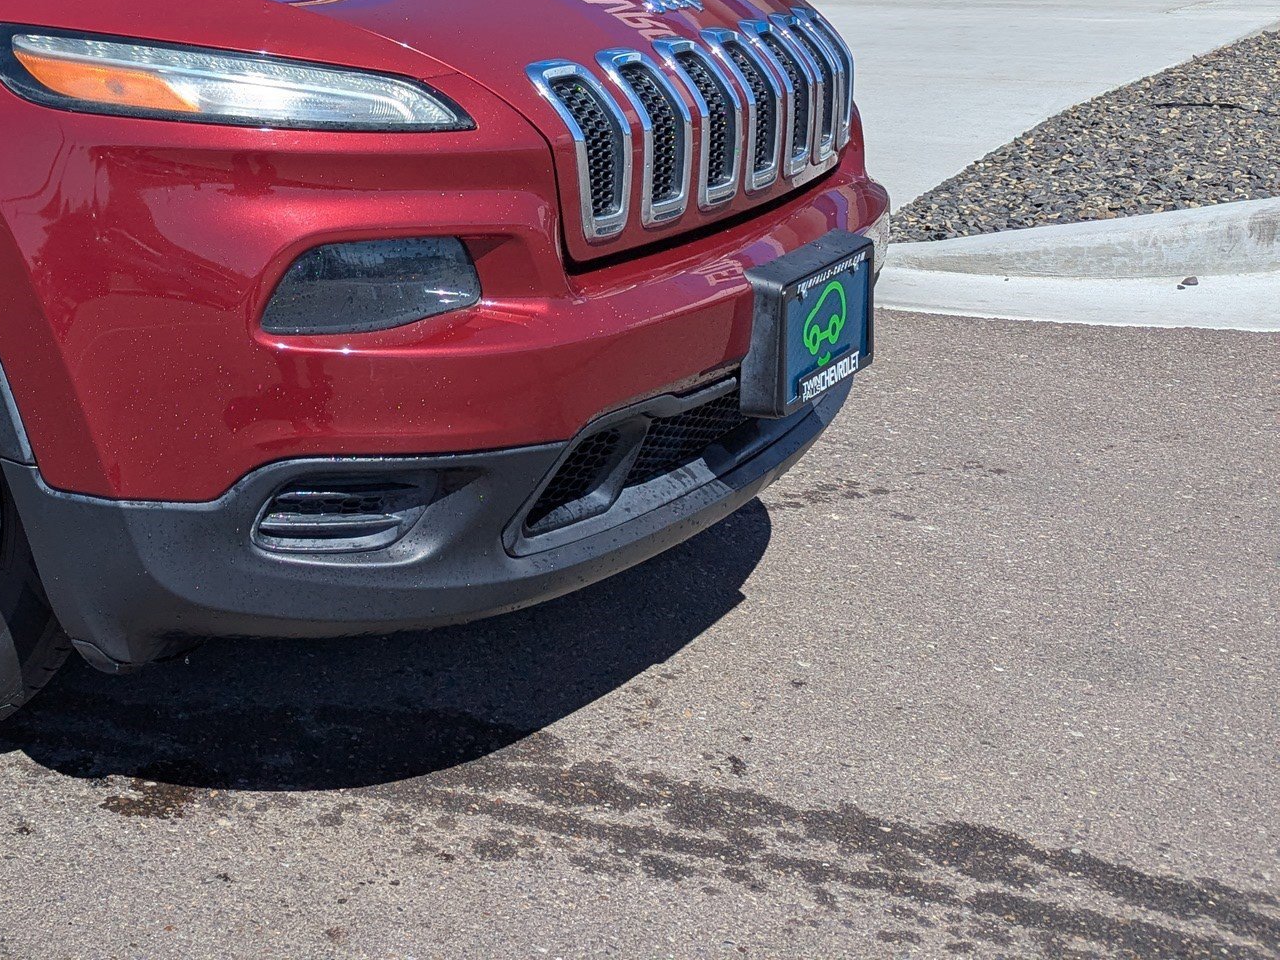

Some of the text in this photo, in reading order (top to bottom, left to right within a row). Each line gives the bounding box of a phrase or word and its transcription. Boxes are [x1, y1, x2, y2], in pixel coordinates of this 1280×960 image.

[819, 350, 860, 391] CHEVROLET
[802, 374, 821, 394] TWIN
[802, 384, 821, 403] FALLS
